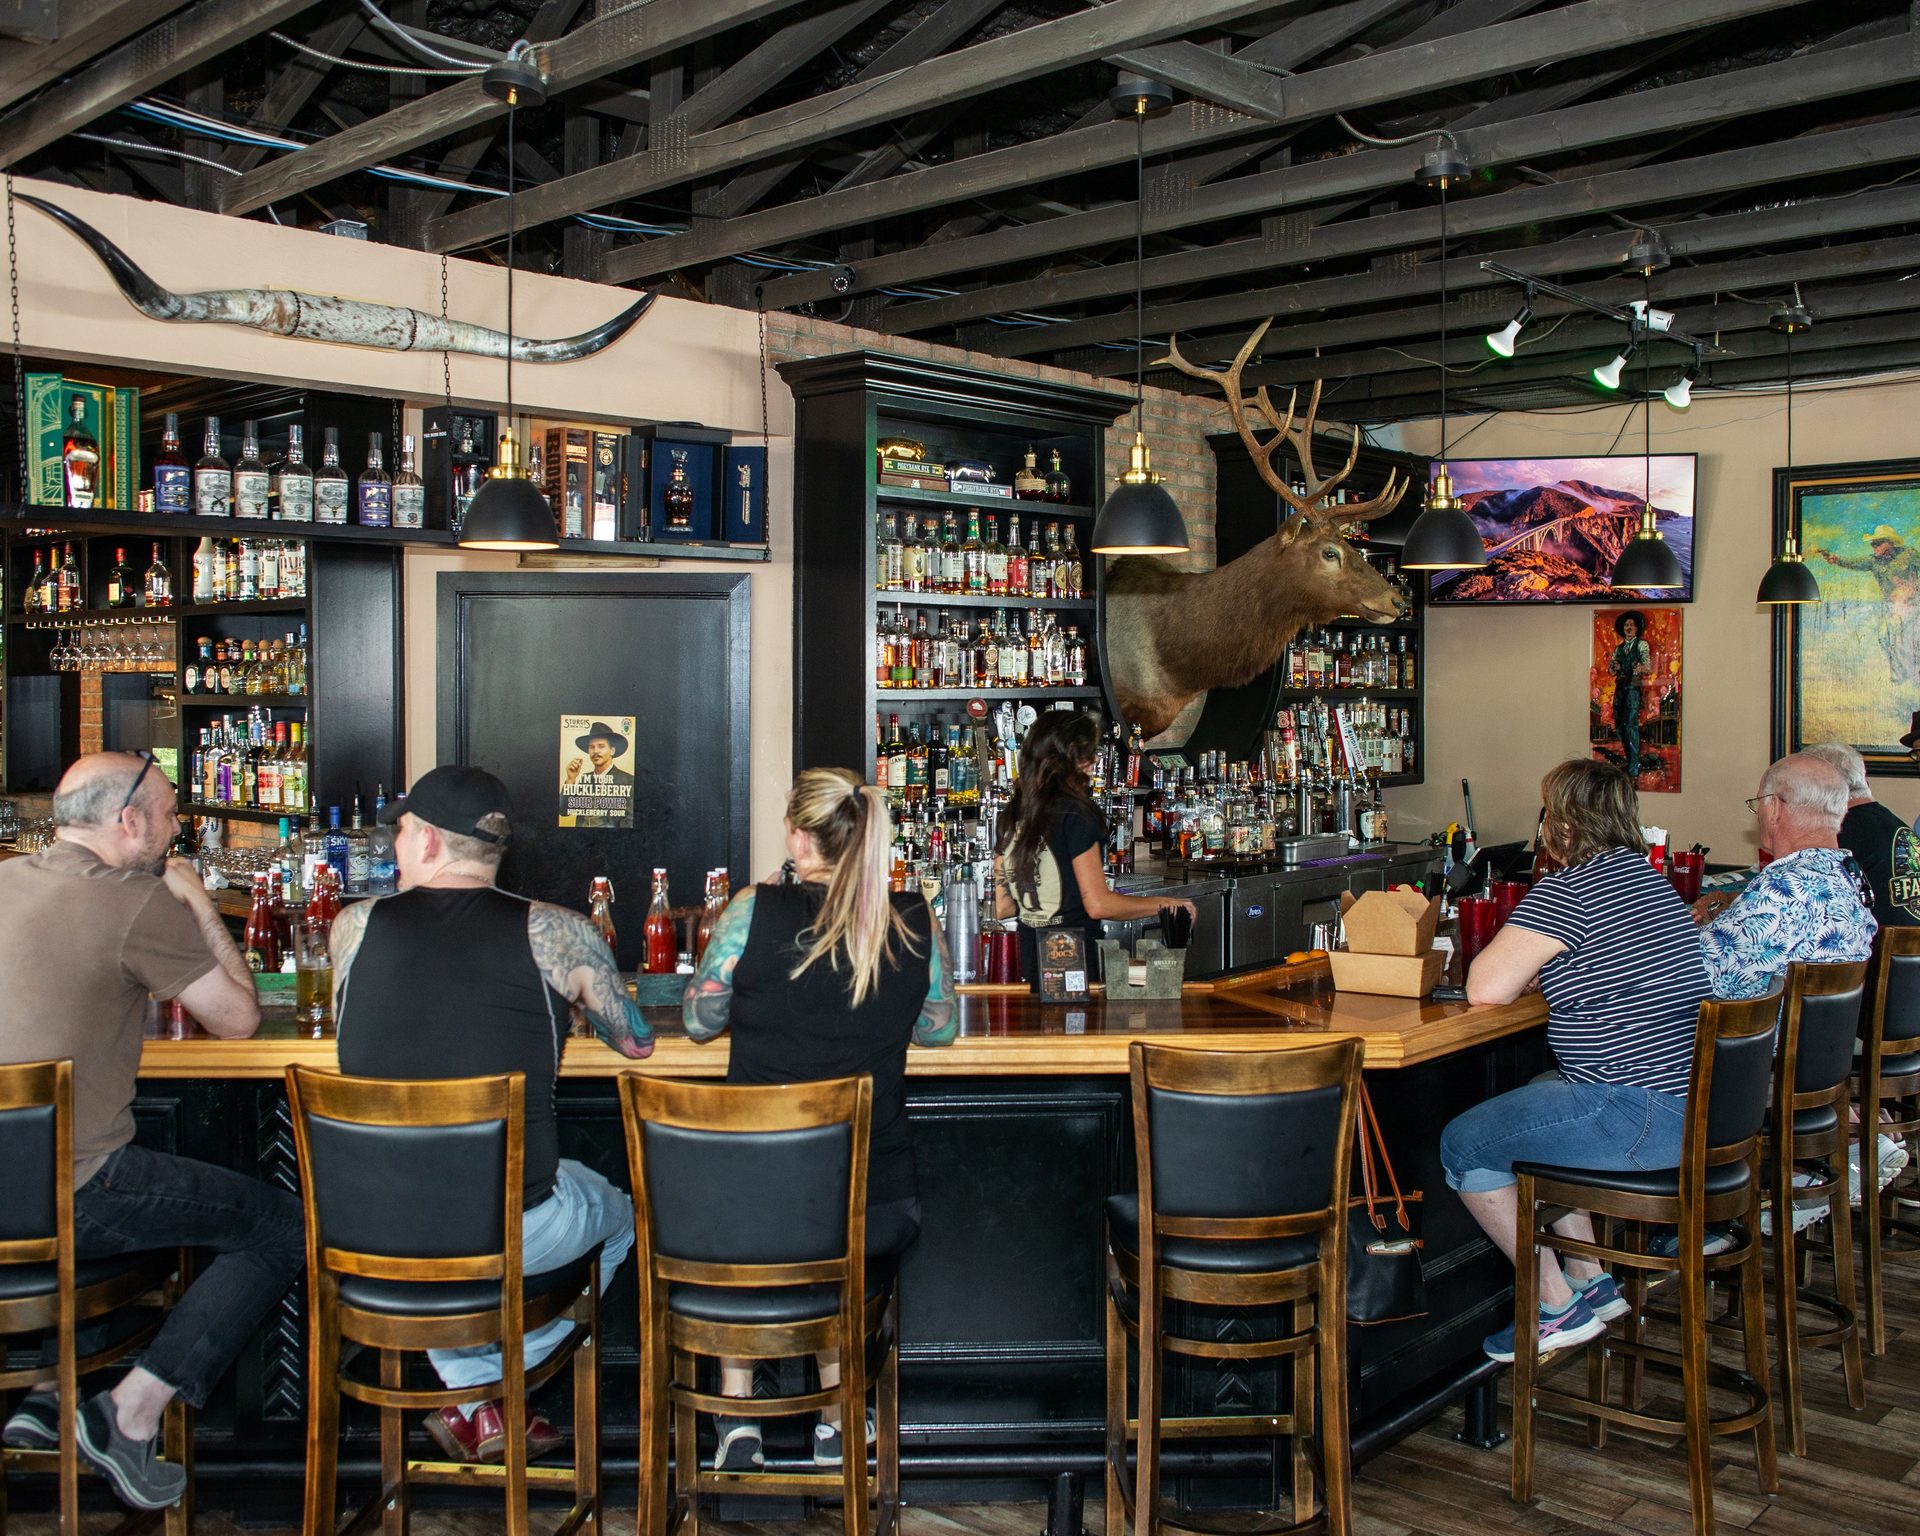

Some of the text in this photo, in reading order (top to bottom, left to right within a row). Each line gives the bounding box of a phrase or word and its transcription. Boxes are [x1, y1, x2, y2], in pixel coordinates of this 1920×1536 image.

[563, 718, 590, 729] STURGIS
[579, 774, 613, 784] I'M YOUR
[563, 784, 632, 797] HUCKLEBERRY
[568, 797, 627, 809] SOUR POWER
[567, 809, 626, 817] HUCKLEBERRY SOUR
